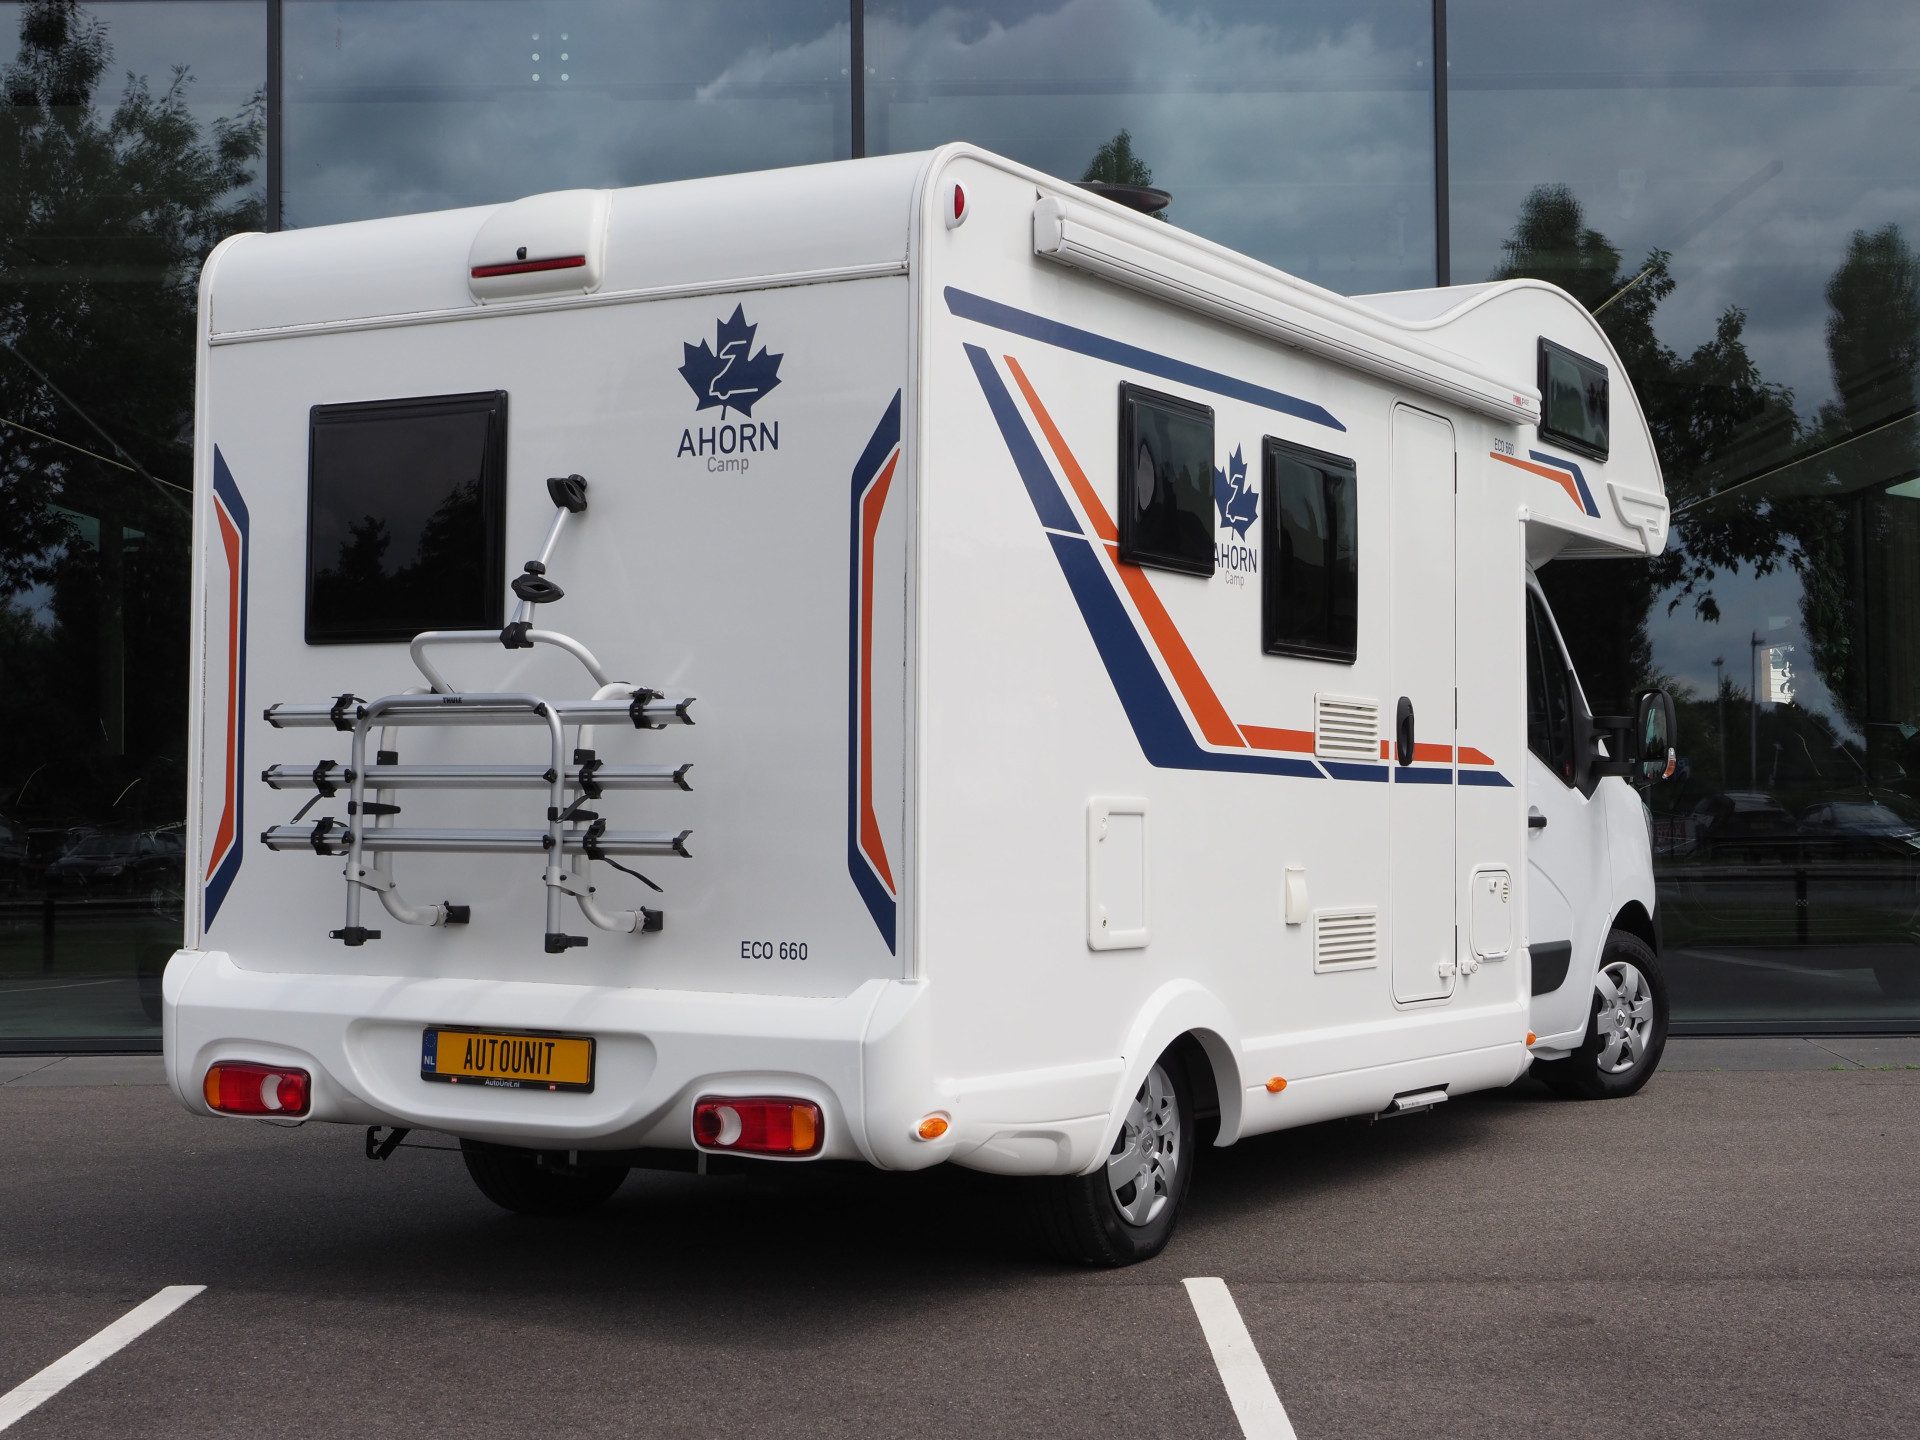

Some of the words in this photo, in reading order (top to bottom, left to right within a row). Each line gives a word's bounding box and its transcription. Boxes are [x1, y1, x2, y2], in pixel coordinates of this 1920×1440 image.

[677, 421, 779, 458] AHORN
[1494, 438, 1505, 453] ECO
[707, 457, 749, 475] Camp
[1225, 570, 1245, 589] Camp
[442, 696, 463, 704] THULE
[741, 941, 773, 959] ECO
[779, 942, 808, 960] 660
[424, 1055, 435, 1066] NL
[463, 1038, 556, 1075] AUTOUNIT
[485, 1079, 520, 1088] AutoUnit.nl
